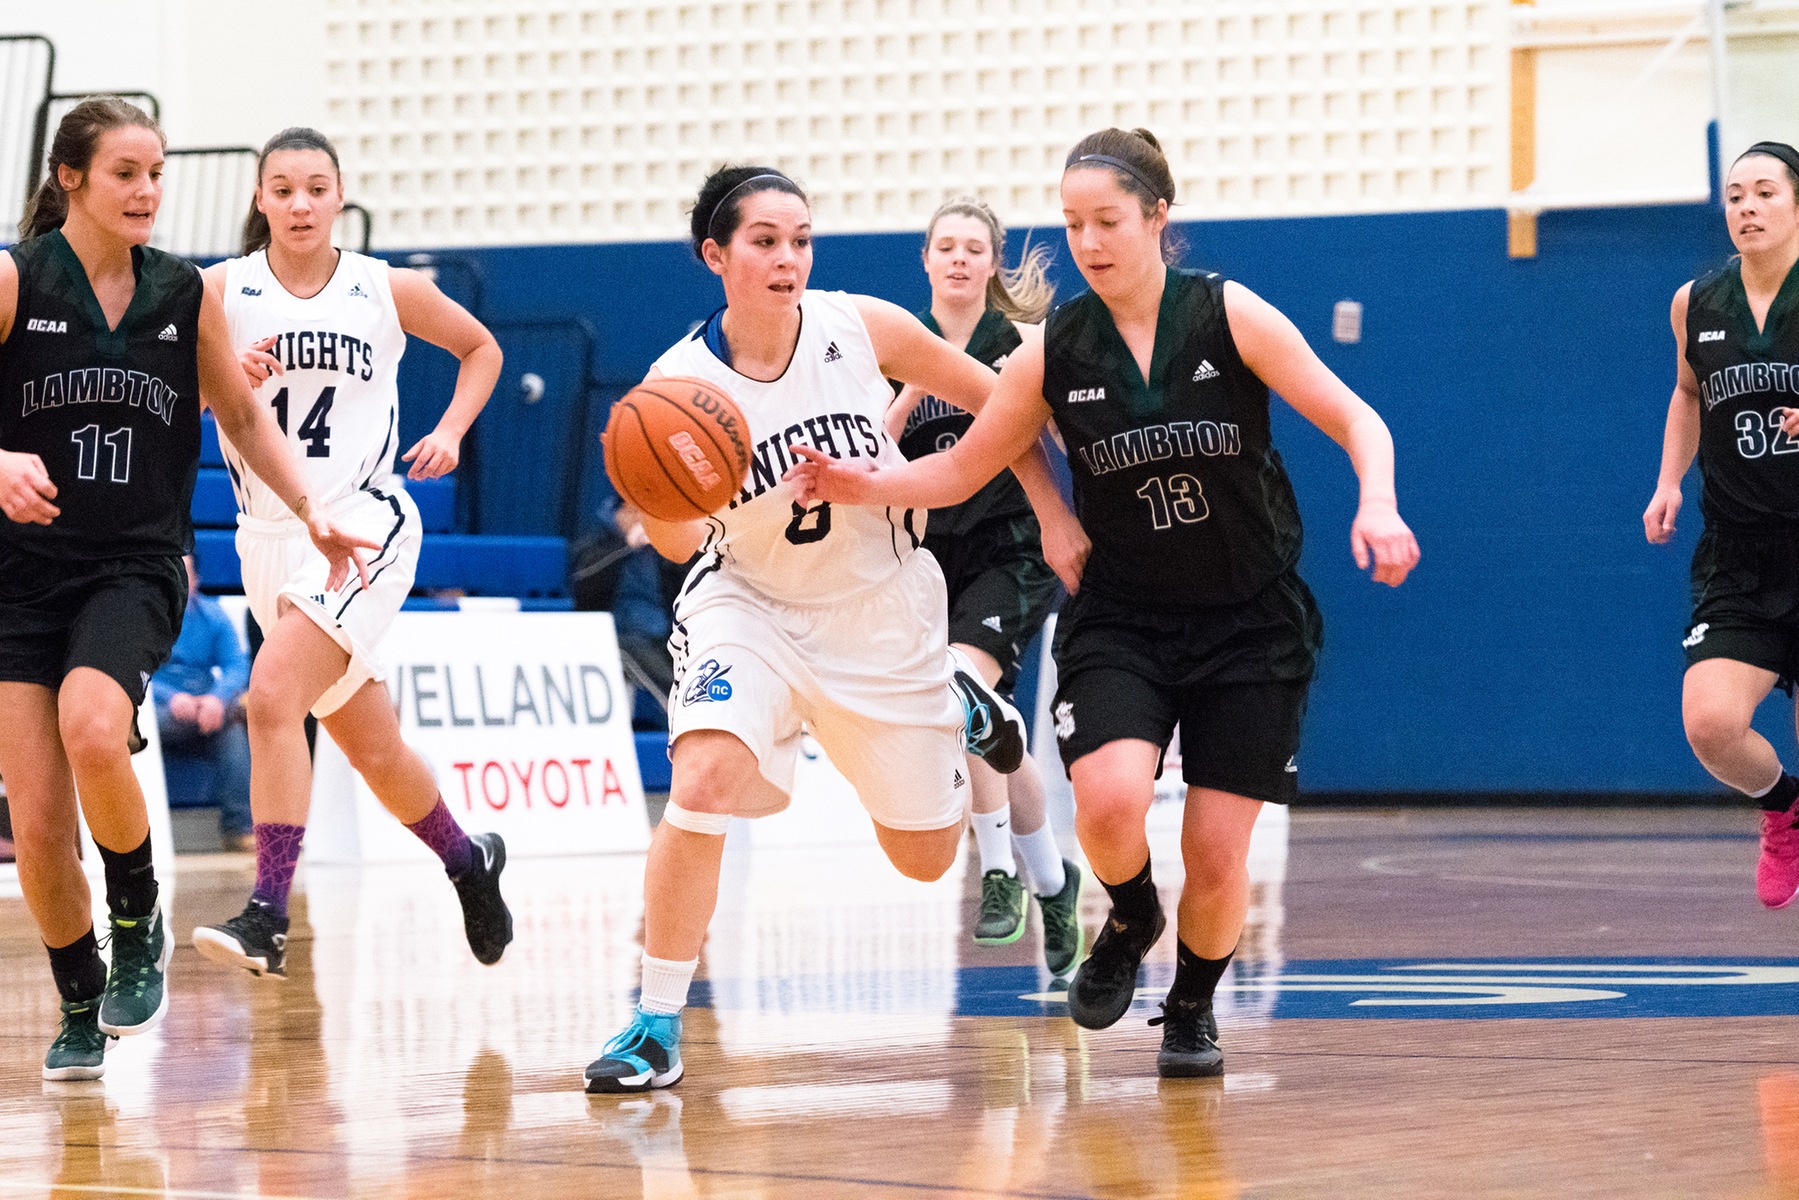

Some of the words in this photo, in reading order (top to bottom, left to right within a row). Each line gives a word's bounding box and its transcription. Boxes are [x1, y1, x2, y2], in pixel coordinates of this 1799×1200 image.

[263, 331, 373, 382] NIGHTS
[1192, 370, 1220, 382] adidas
[22, 368, 178, 426] LAMBTON
[271, 386, 336, 458] 14
[71, 424, 132, 484] 11
[1079, 420, 1242, 476] LAMBTON
[1735, 406, 1799, 458] 32
[728, 413, 879, 510] NIGHTS
[1136, 473, 1209, 530] 13
[711, 684, 729, 696] nc
[452, 758, 628, 811] TOYOTA
